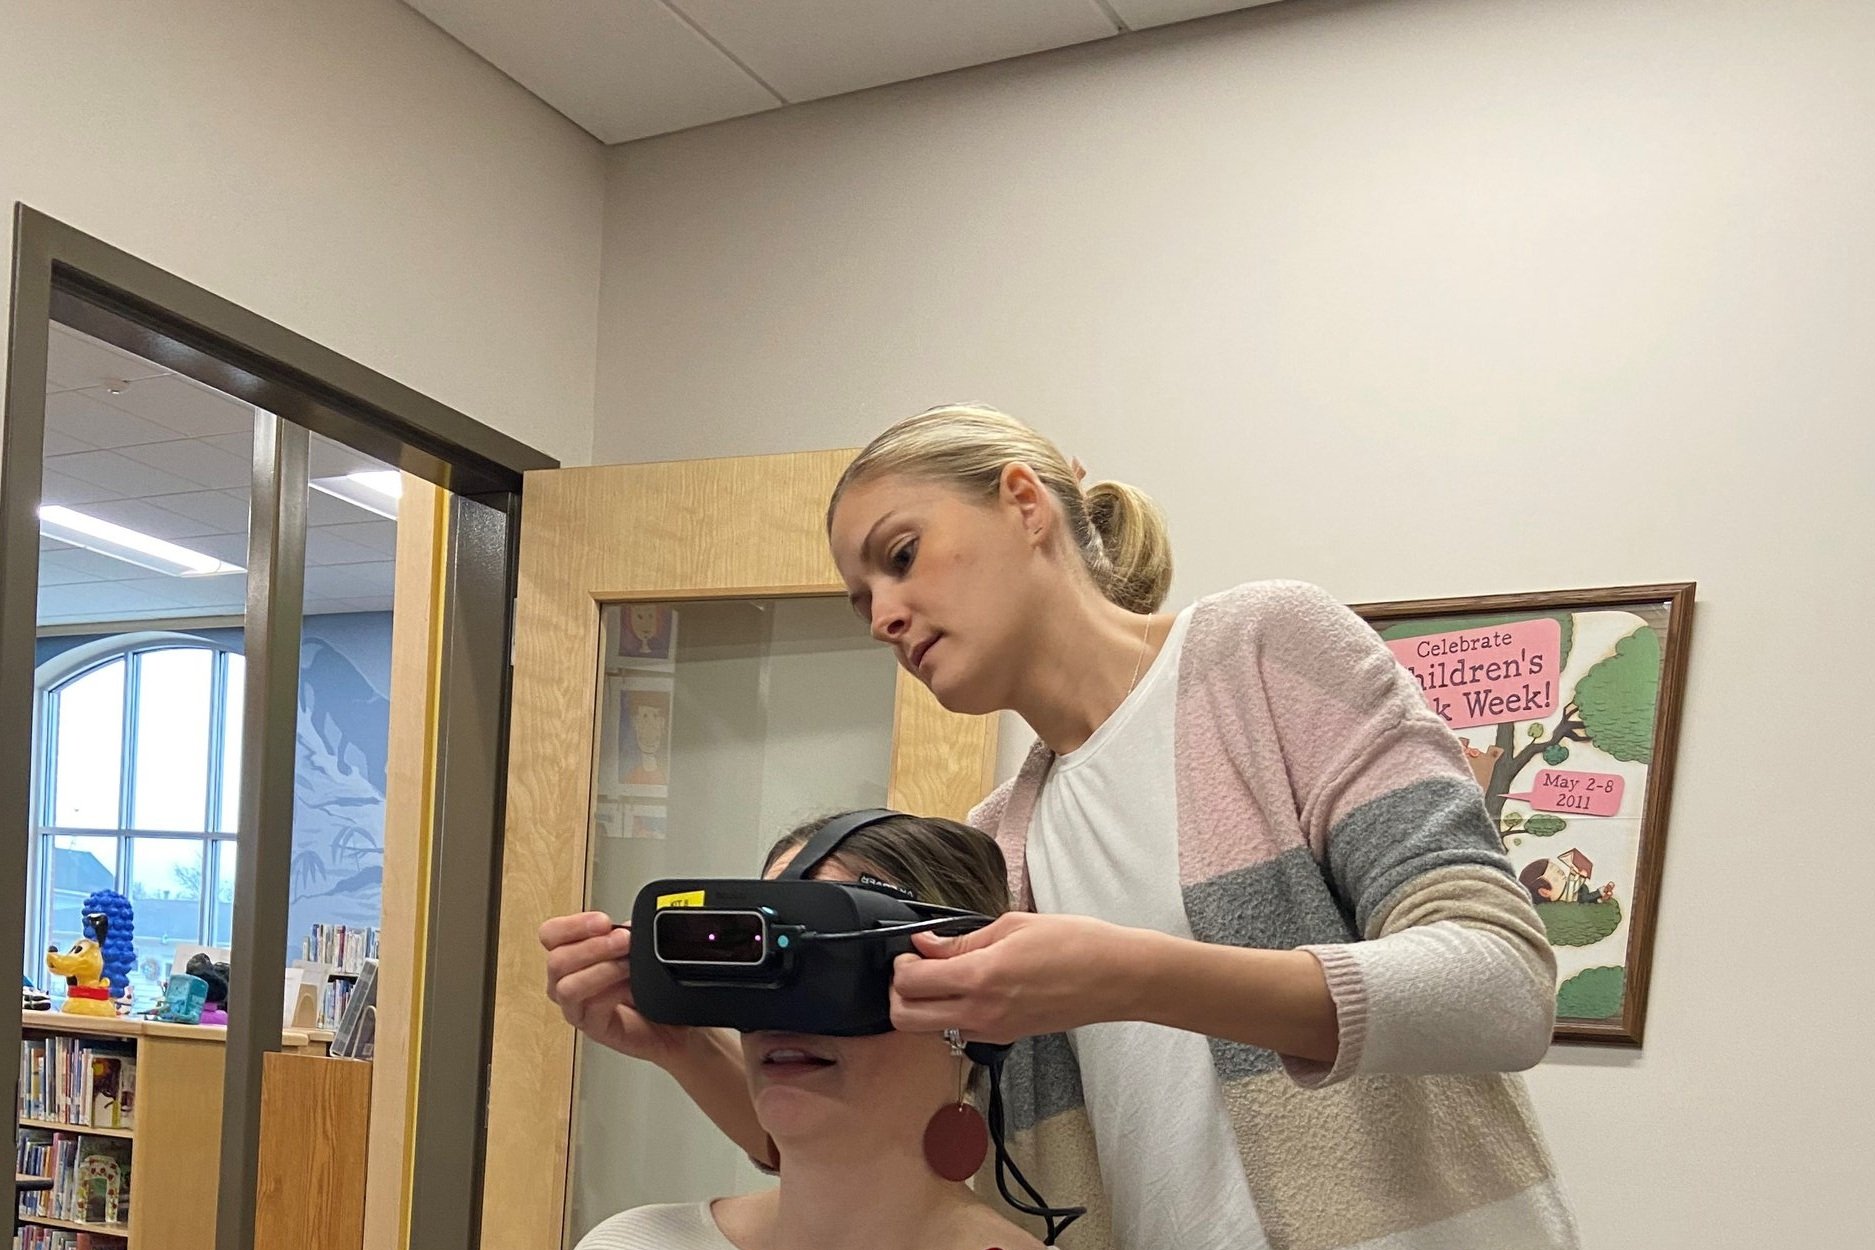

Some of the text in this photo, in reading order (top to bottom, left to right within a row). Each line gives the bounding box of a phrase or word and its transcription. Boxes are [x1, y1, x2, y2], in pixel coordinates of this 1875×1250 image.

[1417, 632, 1512, 658] Celebrate
[1407, 648, 1543, 691] hildren's
[1462, 681, 1551, 719] Week!
[1543, 773, 1614, 793] May 2-8
[1556, 793, 1590, 810] 2011
